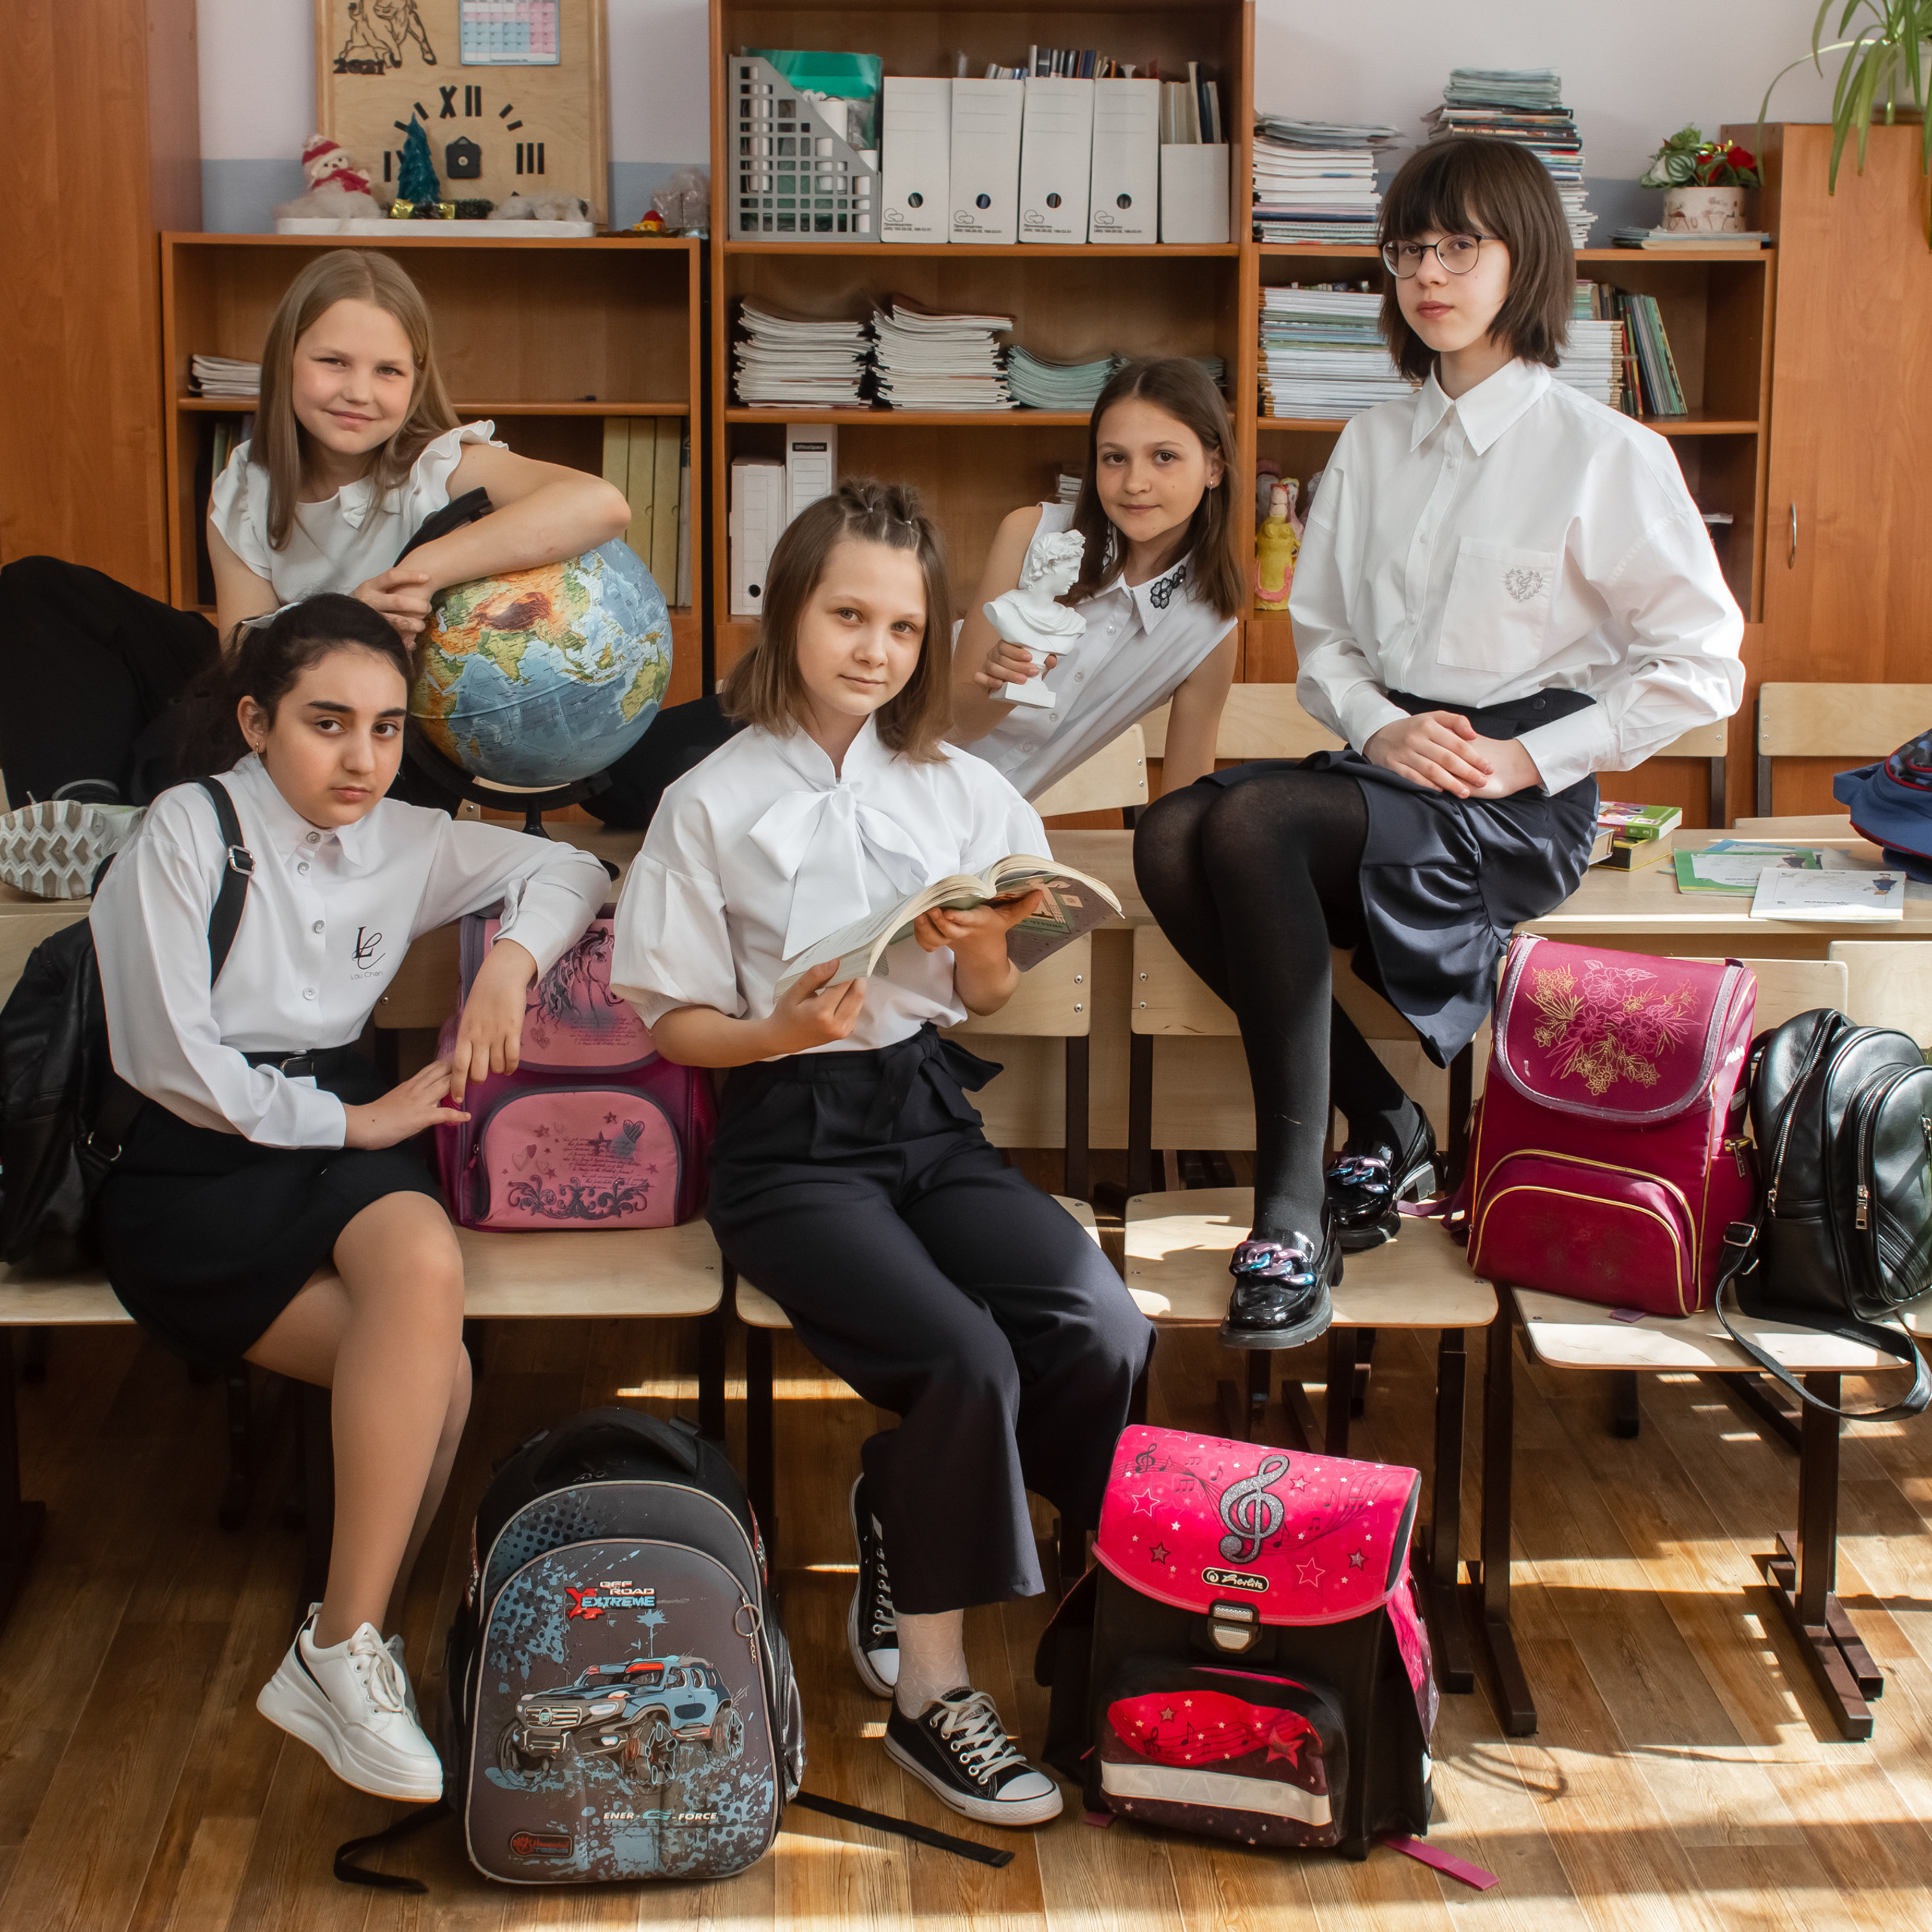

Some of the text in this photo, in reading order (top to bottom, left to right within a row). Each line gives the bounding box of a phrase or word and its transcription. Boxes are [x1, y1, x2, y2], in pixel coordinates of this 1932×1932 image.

[333, 57, 386, 75] 2021
[439, 85, 482, 118] XII
[599, 1580, 632, 1589] OFF
[581, 1595, 656, 1607] EXTREME
